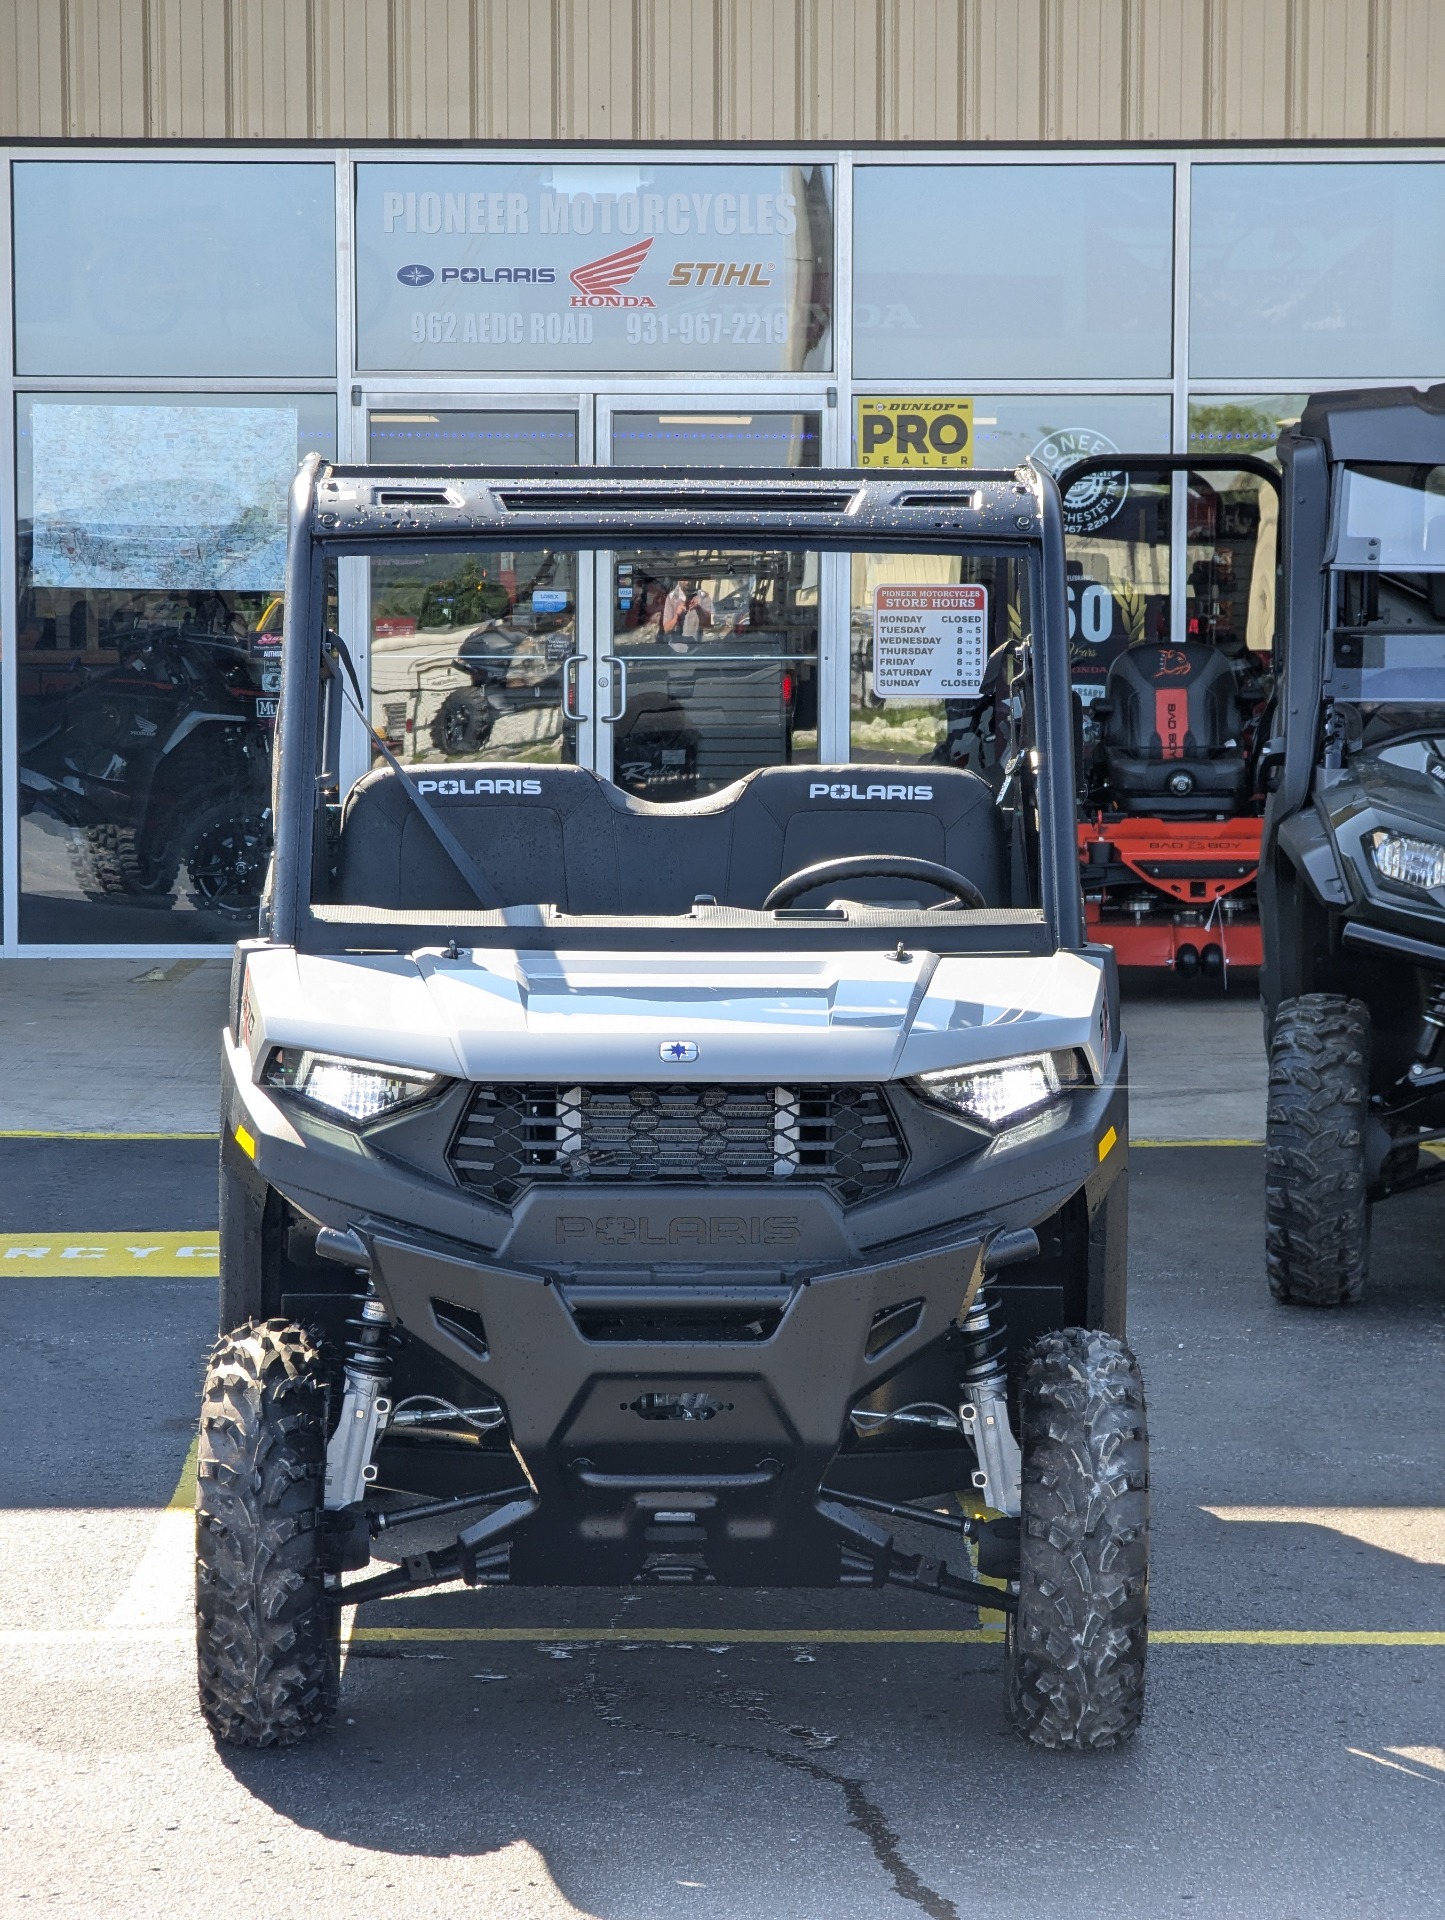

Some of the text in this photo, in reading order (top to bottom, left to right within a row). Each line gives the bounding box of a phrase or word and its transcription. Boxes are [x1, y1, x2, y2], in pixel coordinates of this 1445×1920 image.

[383, 191, 798, 236] PIONEER MOTORCYCLES
[441, 262, 772, 287] POLARIS STIHL
[569, 296, 657, 308] HONDA
[411, 312, 789, 345] 962 AEDC ROAD 931-967-2219
[888, 403, 956, 411] DUNLOP
[862, 414, 969, 455] PRO
[862, 456, 969, 465] DEALER
[1063, 515, 1109, 533] 967-2219
[881, 590, 981, 598] PIONEER MOTORCYCLES
[886, 599, 976, 608] STORE HOURS
[1071, 666, 1109, 674] ONDA
[1167, 703, 1177, 730] BAD
[418, 780, 542, 796] POLARIS
[809, 783, 934, 801] POLARIS
[1150, 842, 1242, 850] BAD BOY
[554, 1216, 801, 1246] POLARIS
[3, 1246, 220, 1259] RCYC
